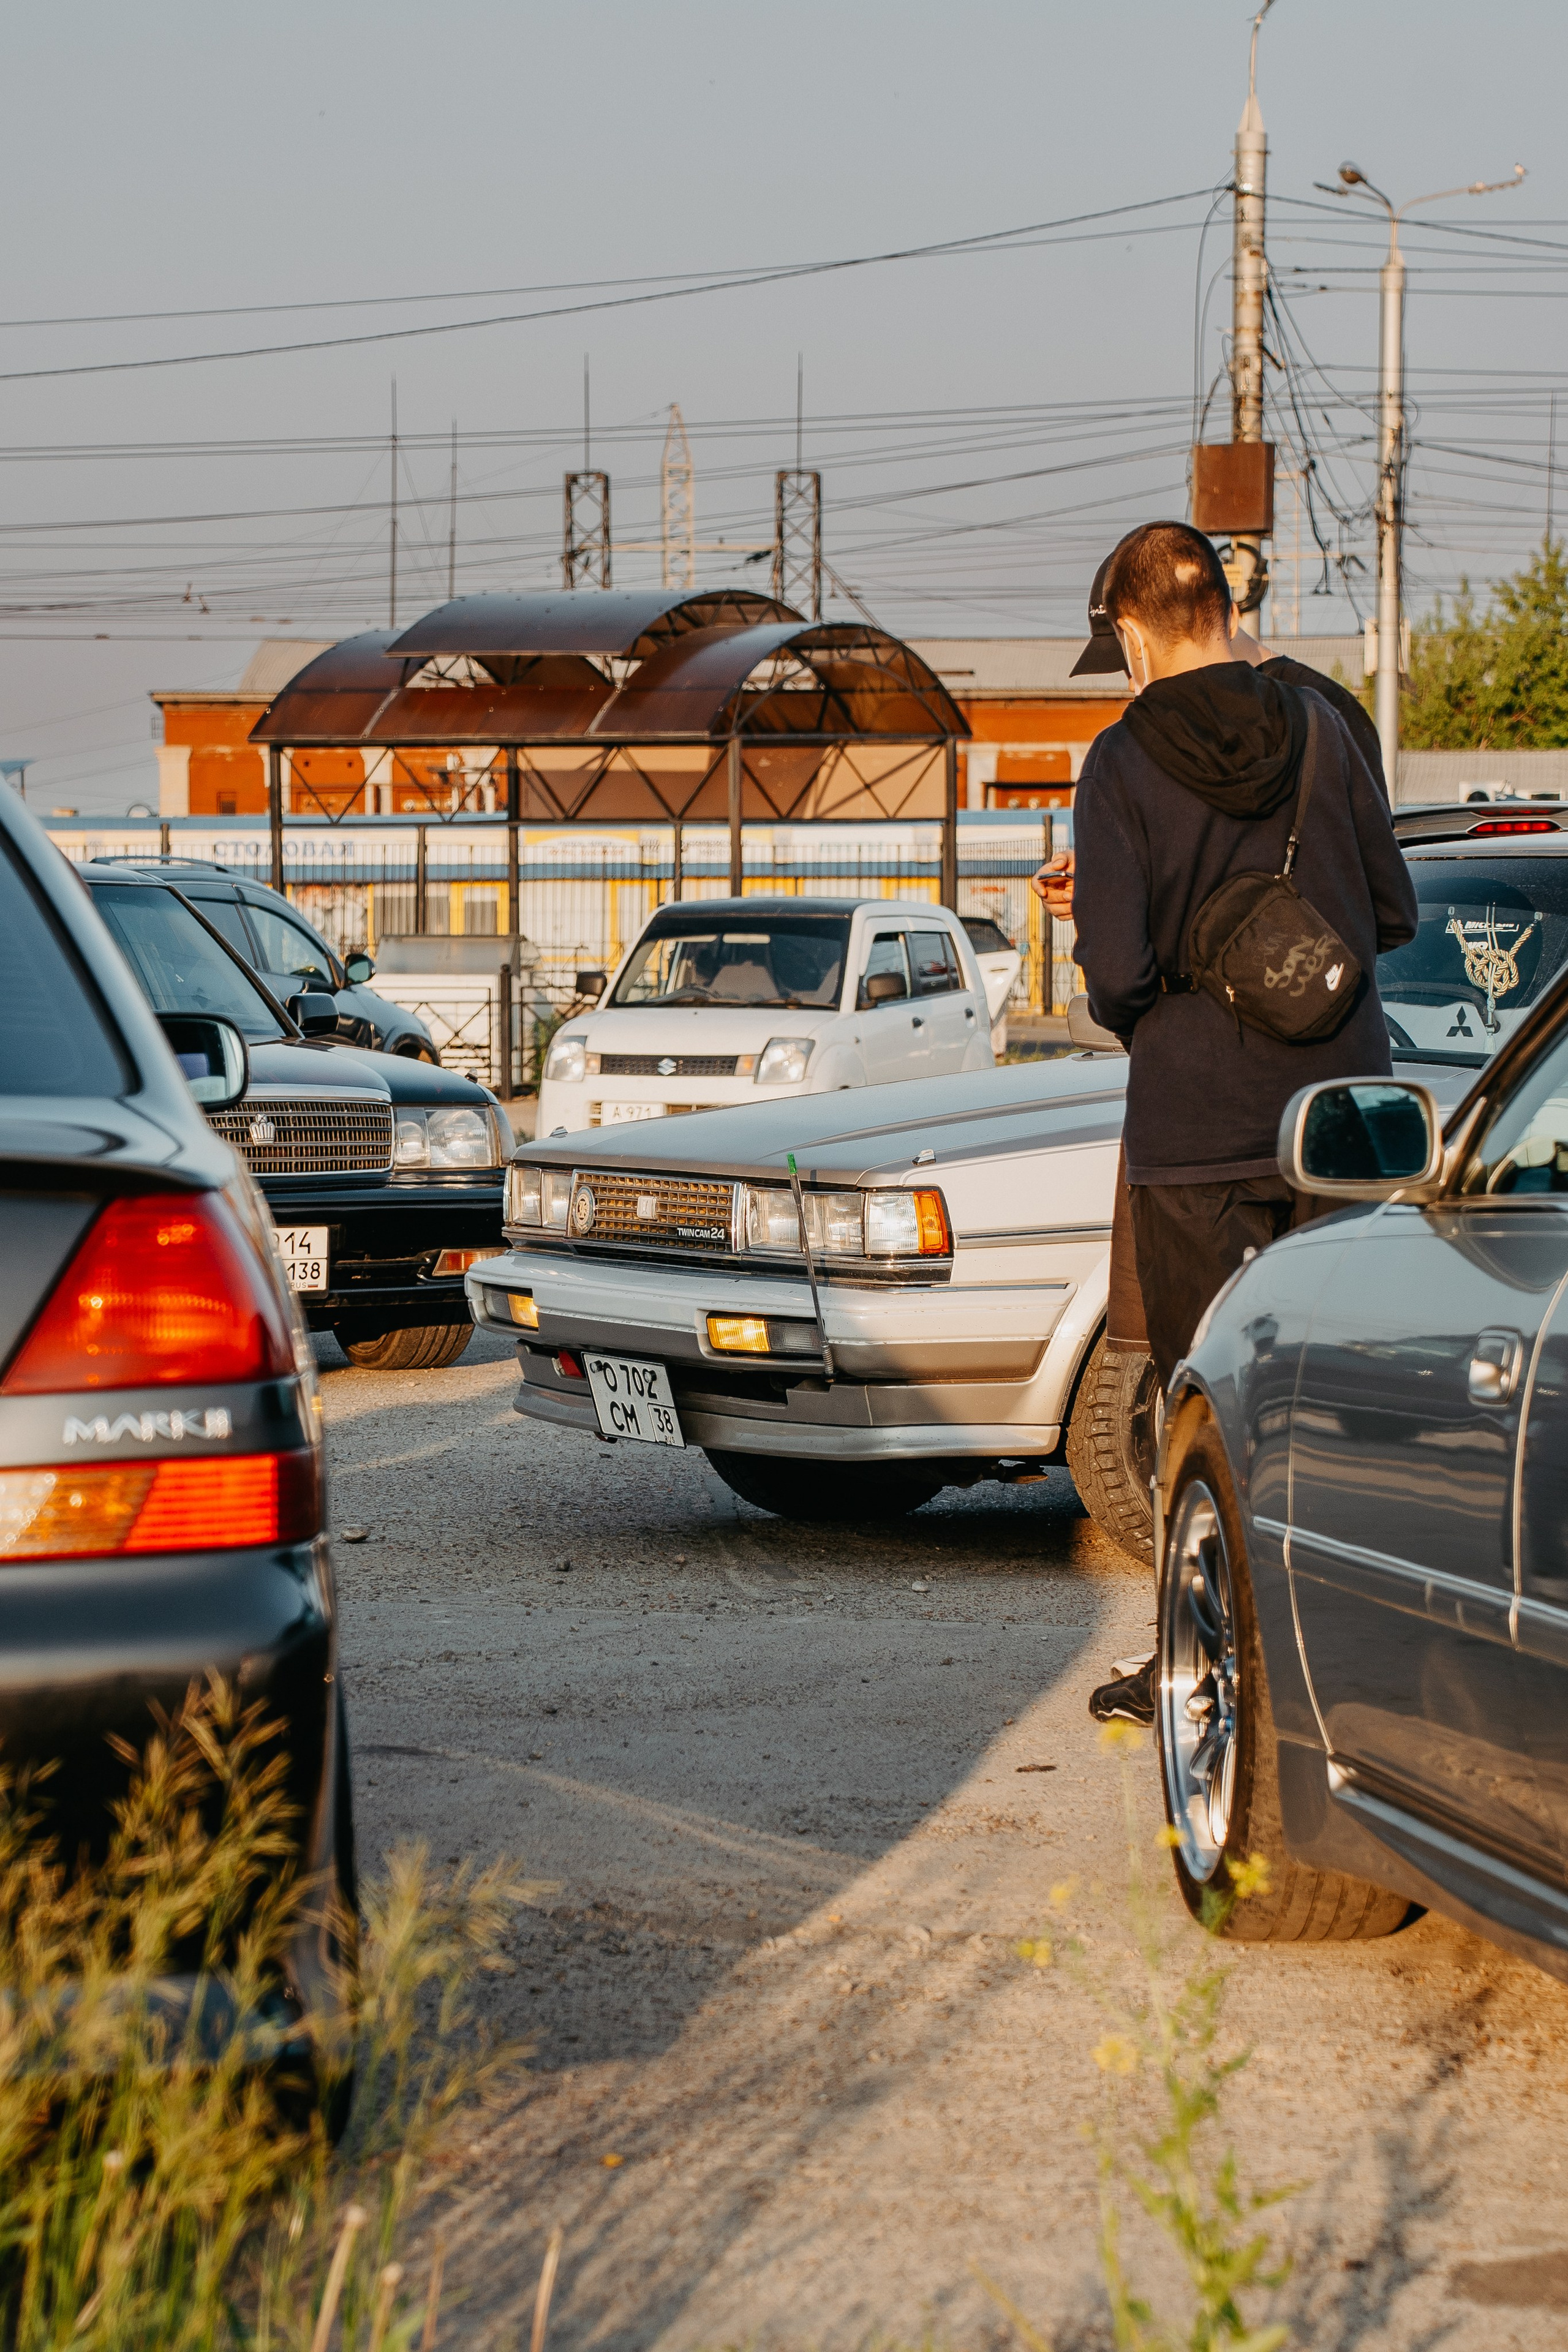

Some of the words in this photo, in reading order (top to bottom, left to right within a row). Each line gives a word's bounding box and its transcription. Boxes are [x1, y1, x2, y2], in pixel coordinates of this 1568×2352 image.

[613, 1104, 622, 1118] A
[627, 1106, 651, 1118] 971
[287, 1262, 320, 1280] 138
[619, 1363, 658, 1400] 702
[610, 1401, 641, 1435] CM
[653, 1408, 674, 1434] 38
[665, 1435, 676, 1444] RUS
